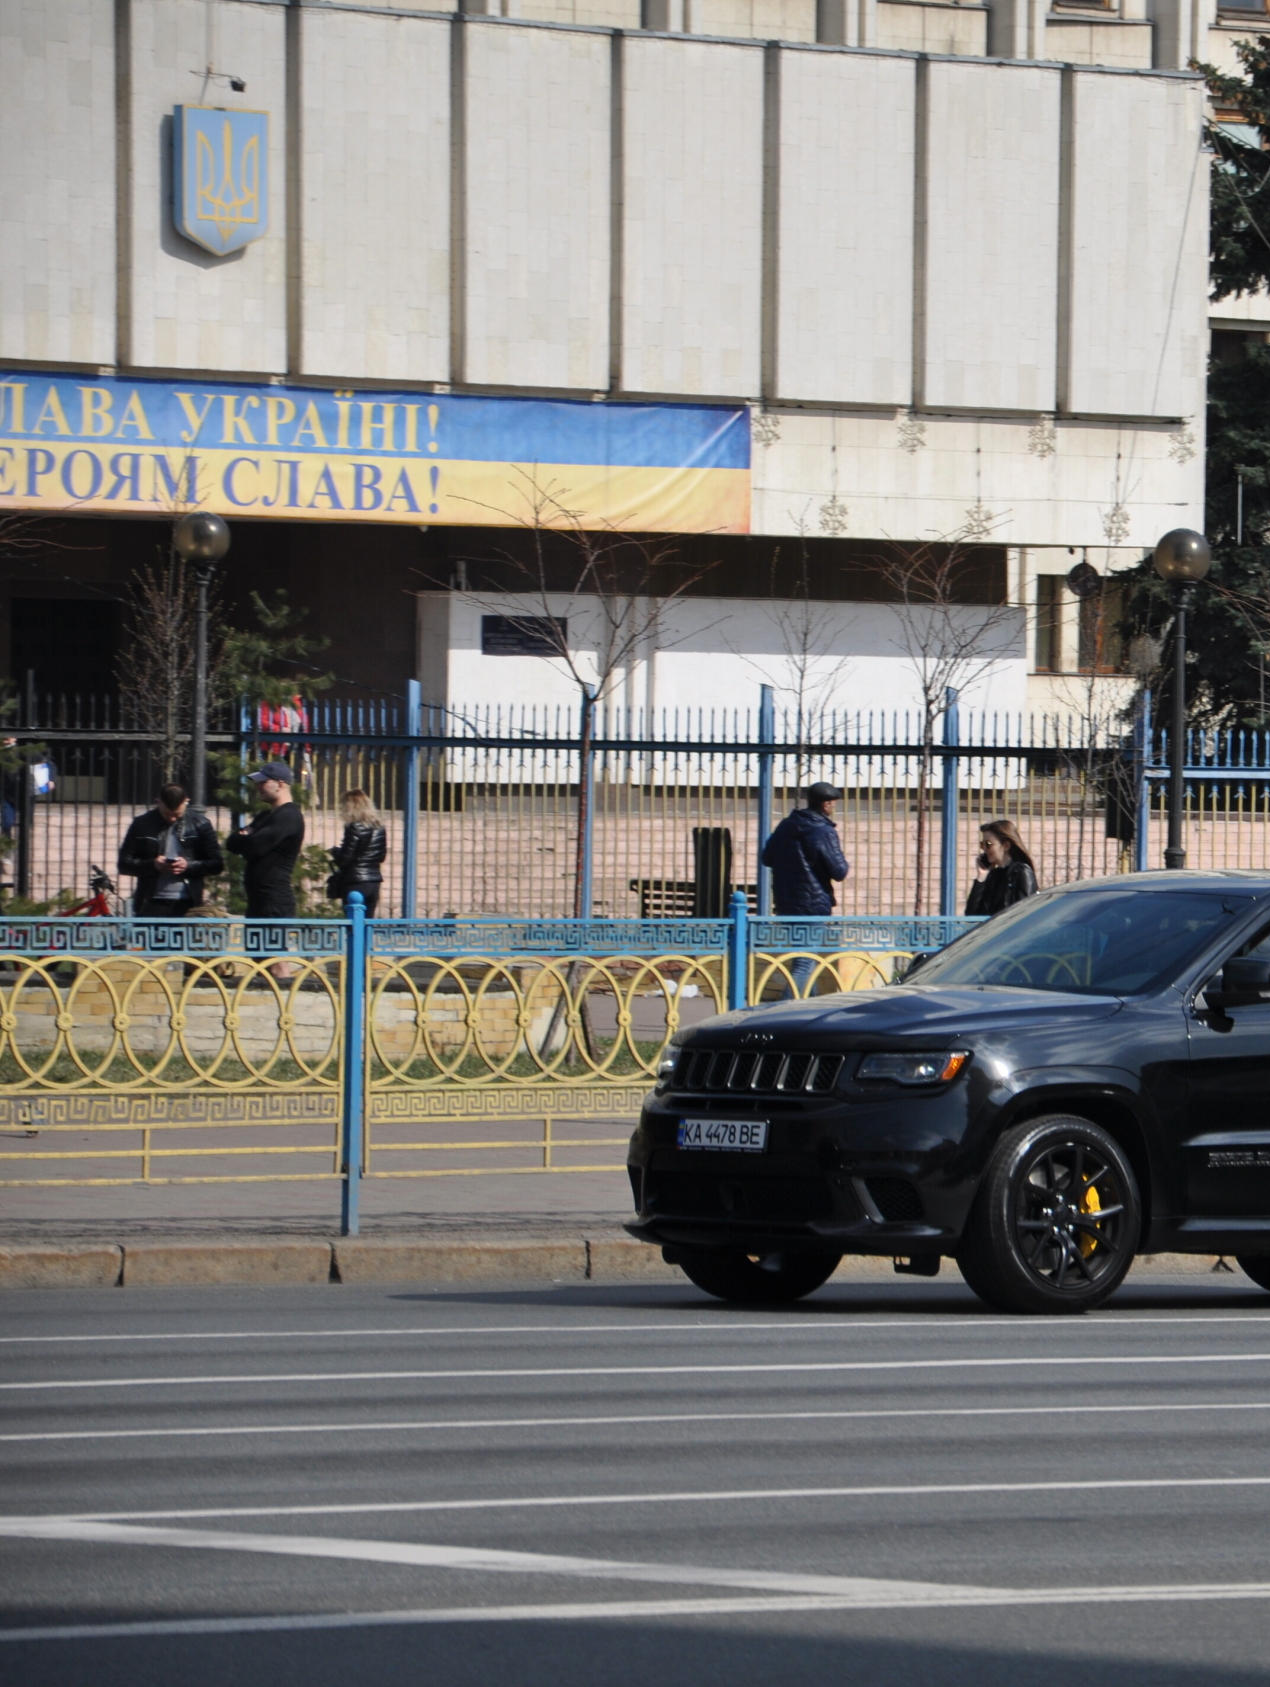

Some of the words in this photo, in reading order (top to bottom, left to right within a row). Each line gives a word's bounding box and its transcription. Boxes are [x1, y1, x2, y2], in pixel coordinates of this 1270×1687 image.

[0, 382, 155, 440] ЛАВА
[175, 389, 440, 453] УКРАЇНІ!
[222, 457, 440, 514] СЛАВА!
[684, 1123, 702, 1144] KA
[705, 1123, 737, 1144] 4478
[739, 1124, 761, 1145] BE
